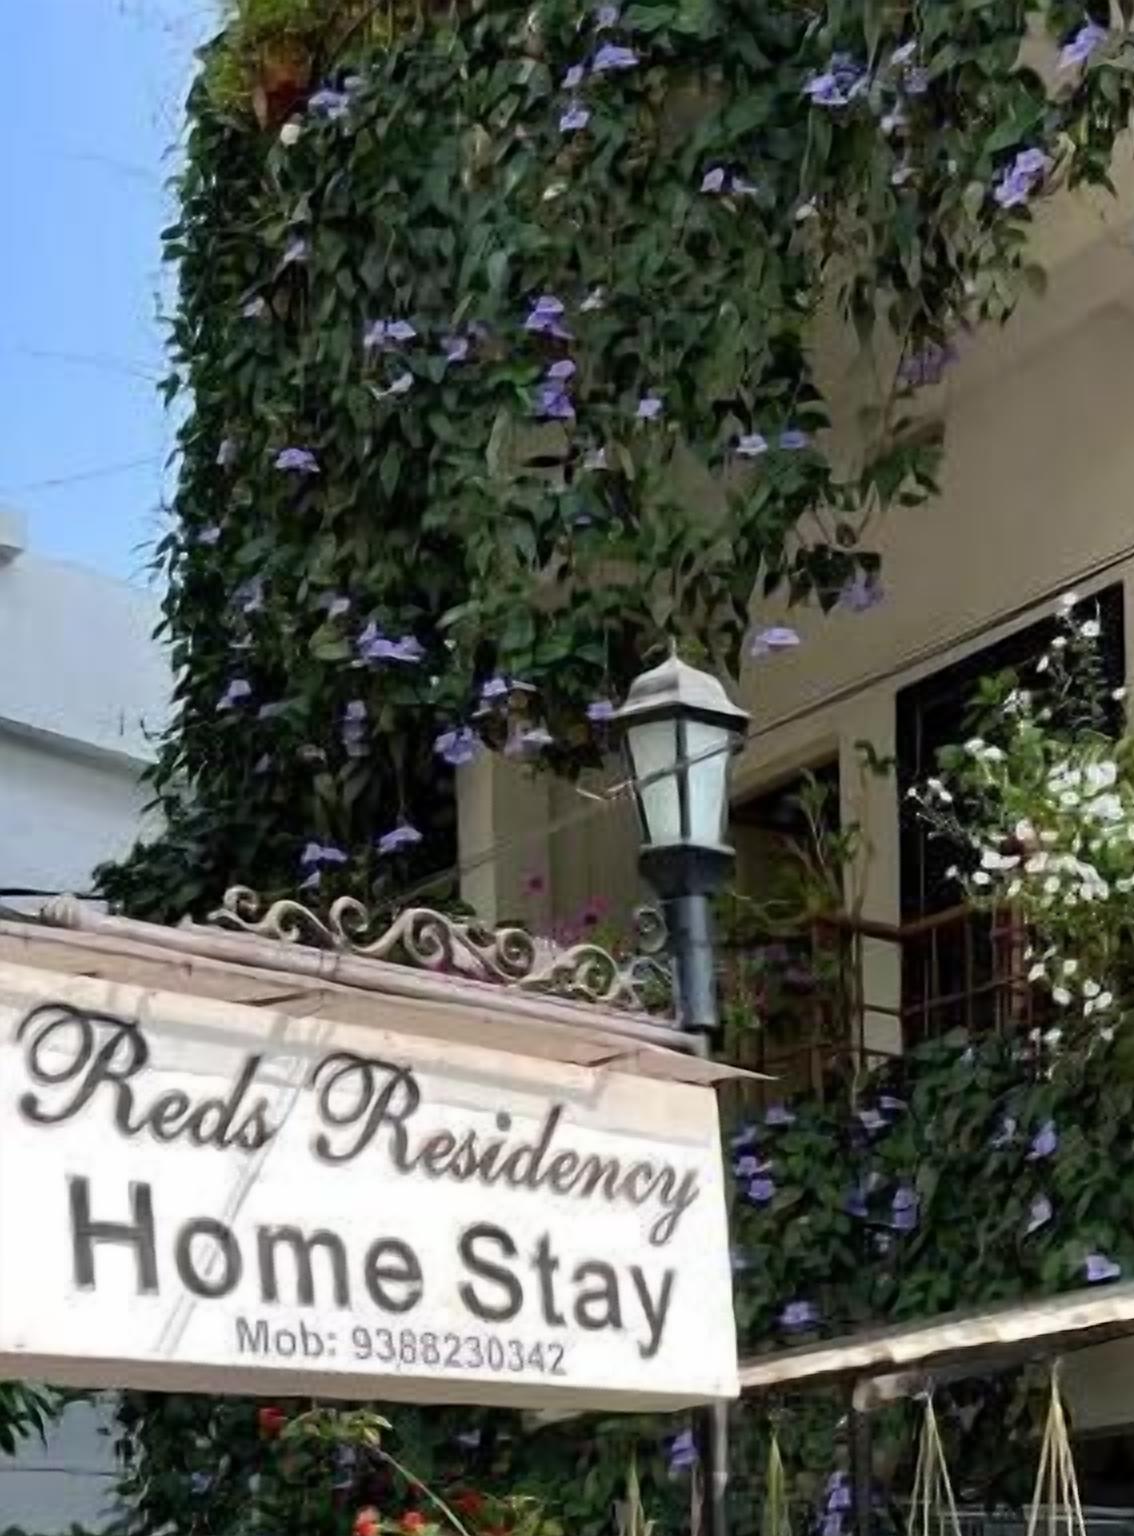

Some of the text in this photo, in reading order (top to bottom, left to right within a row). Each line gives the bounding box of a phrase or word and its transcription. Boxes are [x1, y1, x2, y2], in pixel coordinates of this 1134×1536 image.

[15, 1003, 699, 1246] Reds Residency
[68, 1175, 676, 1360] Home Stay
[235, 1316, 337, 1358] Mob:
